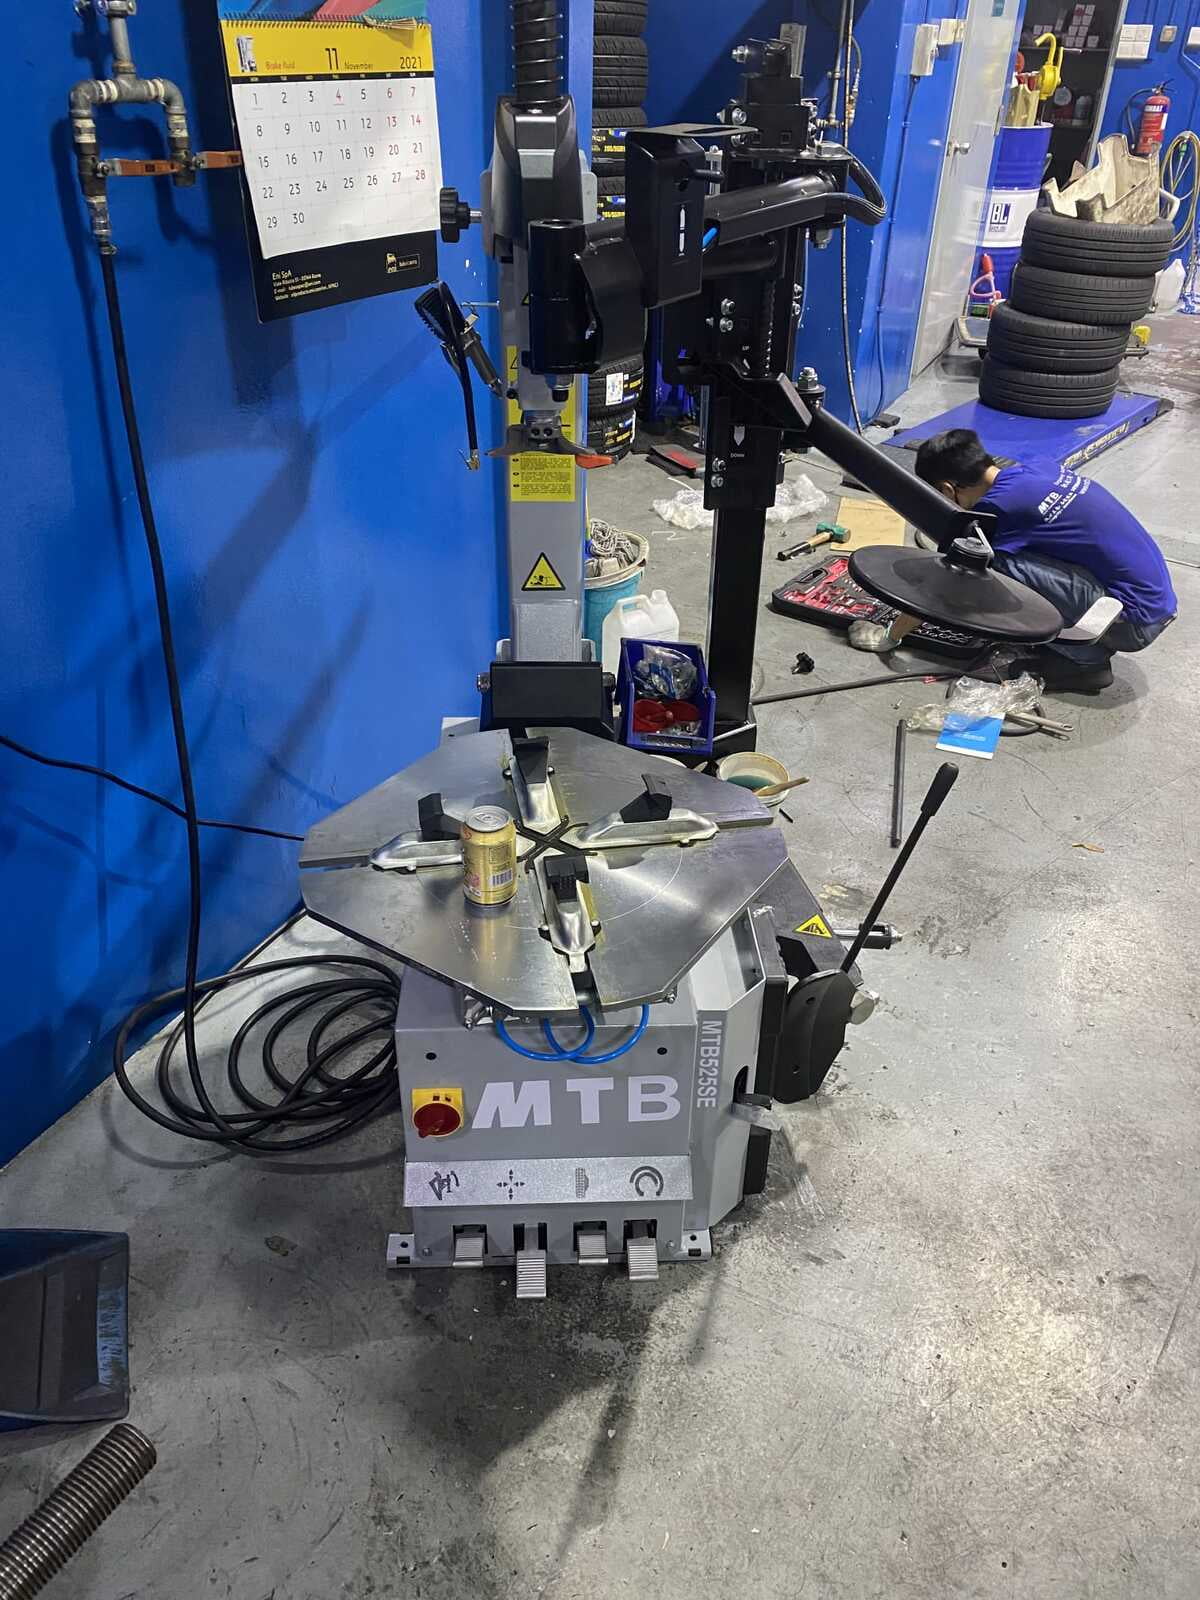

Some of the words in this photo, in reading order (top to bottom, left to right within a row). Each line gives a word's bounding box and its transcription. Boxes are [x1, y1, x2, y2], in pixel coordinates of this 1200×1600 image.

[325, 48, 339, 70] 11
[344, 60, 373, 70] November
[399, 56, 422, 70] 2021
[252, 92, 258, 105] 1
[281, 91, 288, 104] 2
[308, 90, 314, 103] 3
[335, 90, 342, 102] 4
[360, 88, 367, 100] 5
[386, 87, 393, 99] 6
[410, 86, 416, 97] 7
[256, 124, 263, 137] 8
[284, 122, 291, 135] 9
[308, 120, 321, 133] 10
[336, 119, 347, 130] 11
[360, 117, 372, 129] 12
[386, 115, 397, 128] 13
[411, 114, 421, 125] 14
[258, 155, 270, 169] 15
[285, 152, 297, 165] 16
[312, 150, 323, 163] 17
[339, 148, 351, 160] 18
[363, 145, 375, 158] 19
[388, 144, 400, 156] 20
[412, 142, 423, 154] 21
[262, 186, 274, 199] 22
[289, 183, 301, 195] 23
[315, 180, 328, 192] 24
[343, 176, 354, 189] 25
[366, 174, 378, 186] 26
[391, 171, 402, 184] 27
[415, 169, 426, 181] 28
[266, 216, 278, 229] 29
[292, 212, 305, 225] 30
[990, 203, 1010, 224] BL
[1038, 491, 1059, 514] MTB
[697, 1020, 722, 1108] MTB525SE
[471, 1075, 681, 1129] MTB
